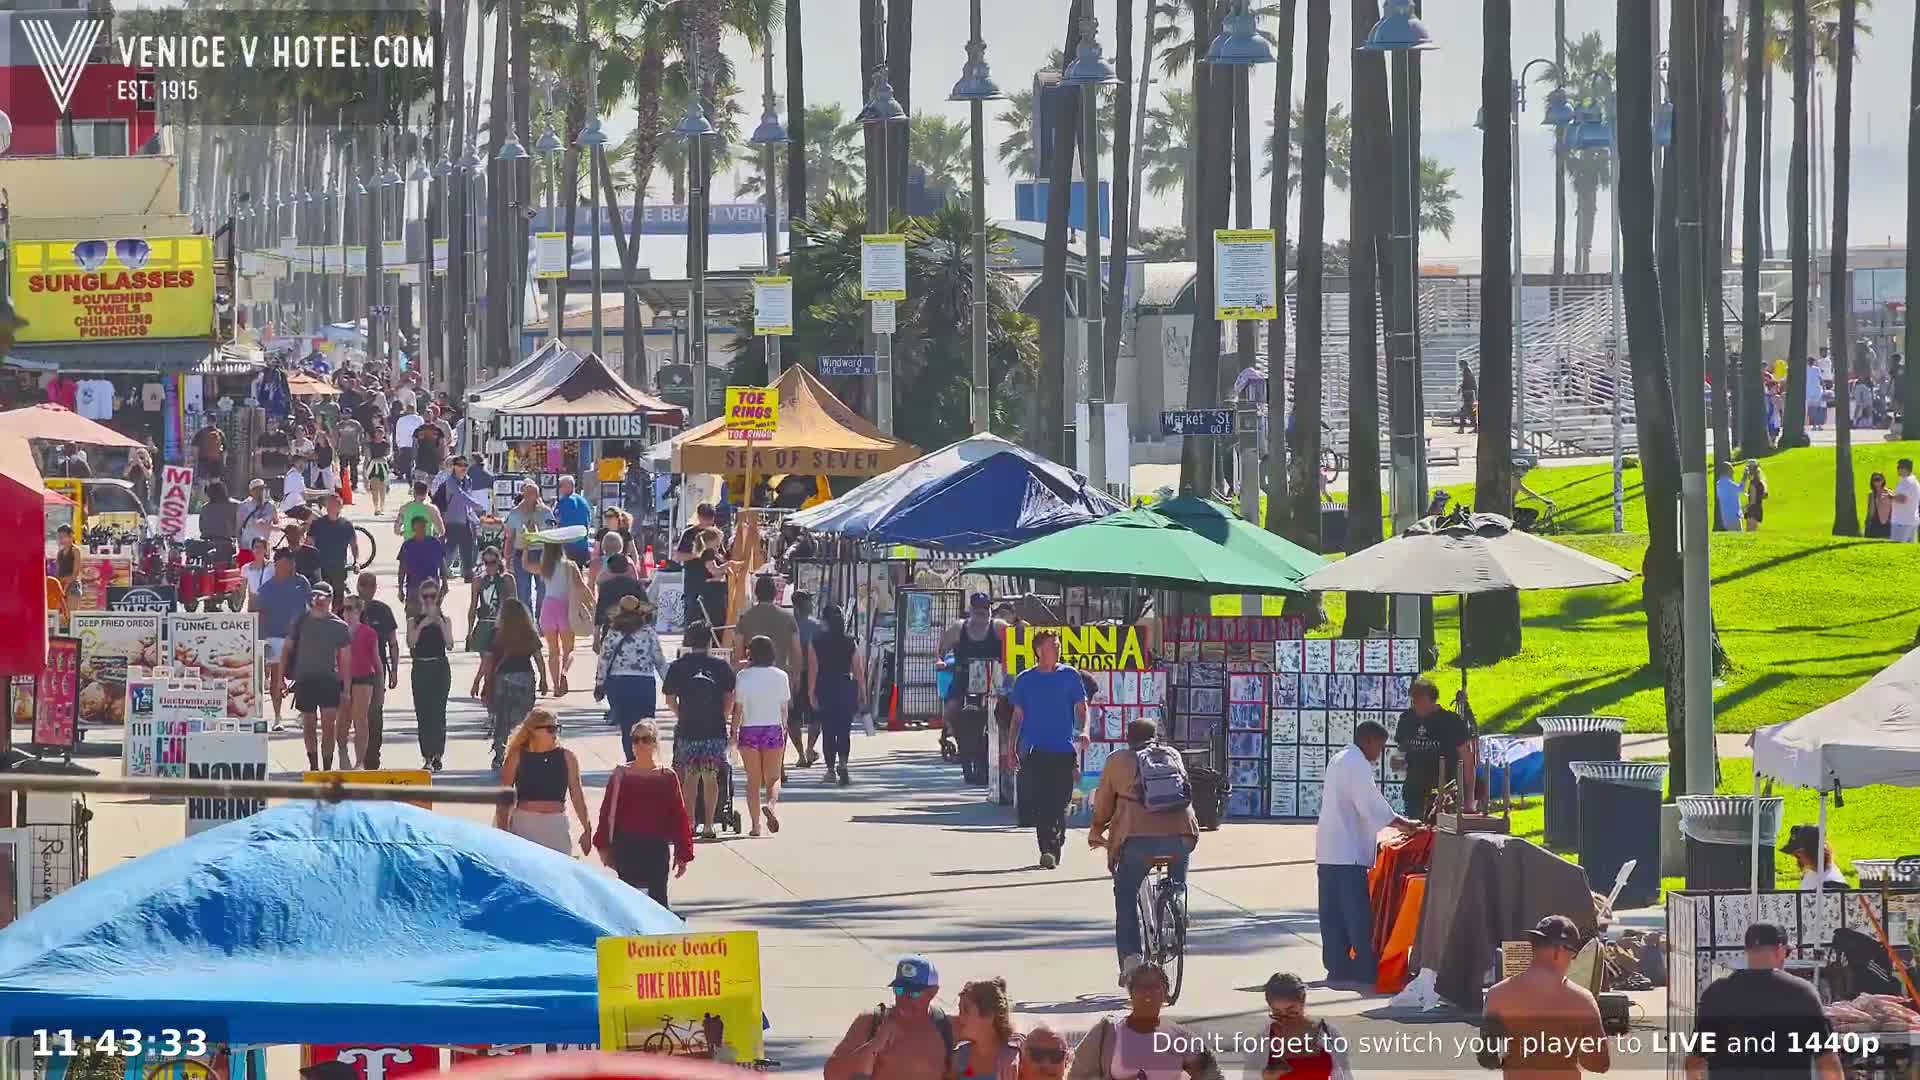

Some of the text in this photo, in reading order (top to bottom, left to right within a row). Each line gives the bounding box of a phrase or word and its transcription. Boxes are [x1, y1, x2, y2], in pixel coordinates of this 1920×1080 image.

[28, 270, 195, 293] SUNGLASSES
[72, 292, 153, 305] SOUVENIRS
[84, 304, 141, 315] TOWELS
[74, 314, 153, 327] CHILDRENS
[79, 325, 147, 338] PONCHOS
[822, 357, 862, 368] Windward
[737, 391, 766, 404] TOE
[731, 405, 772, 419] RINGS
[1164, 411, 1231, 425] Market St
[500, 414, 642, 440] HENNA TATTOOS
[725, 450, 879, 469] SEA OF SEVEN
[129, 594, 153, 604] THE
[78, 619, 154, 628] DEEP FRIED OREOS
[175, 620, 251, 632] FUNNEL CAKE
[1006, 624, 1145, 675] HNNA
[636, 969, 721, 1000] BIKE RENTALS
